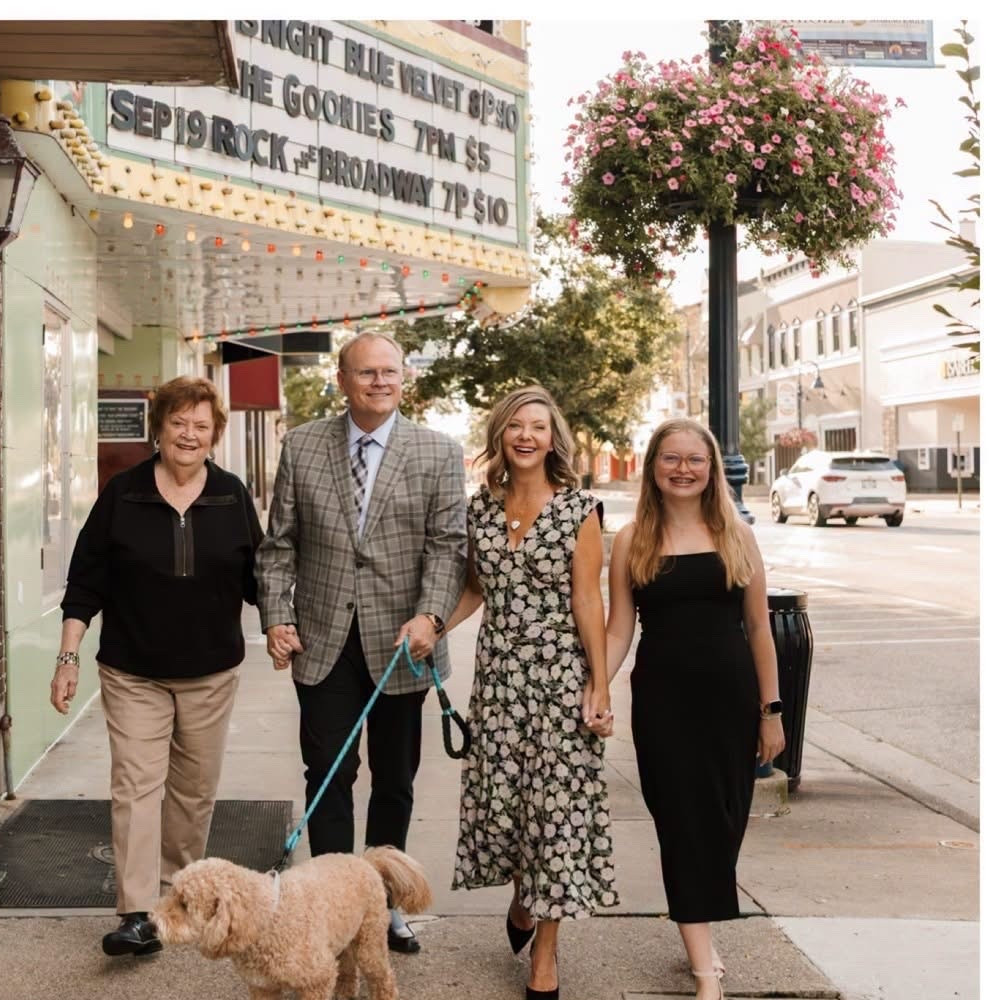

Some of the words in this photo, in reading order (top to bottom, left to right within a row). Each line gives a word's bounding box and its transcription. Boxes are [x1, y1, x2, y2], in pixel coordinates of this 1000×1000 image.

[283, 73, 395, 142] GOONIES
[414, 120, 456, 163] 7PM
[465, 135, 491, 172] $5
[344, 38, 394, 88] BLUE
[399, 60, 464, 112] VELVET
[111, 89, 172, 139] SEP
[212, 115, 288, 172] ROCK
[319, 146, 433, 208] BROADWAY
[442, 180, 469, 219] 7P
[474, 188, 508, 226] $10
